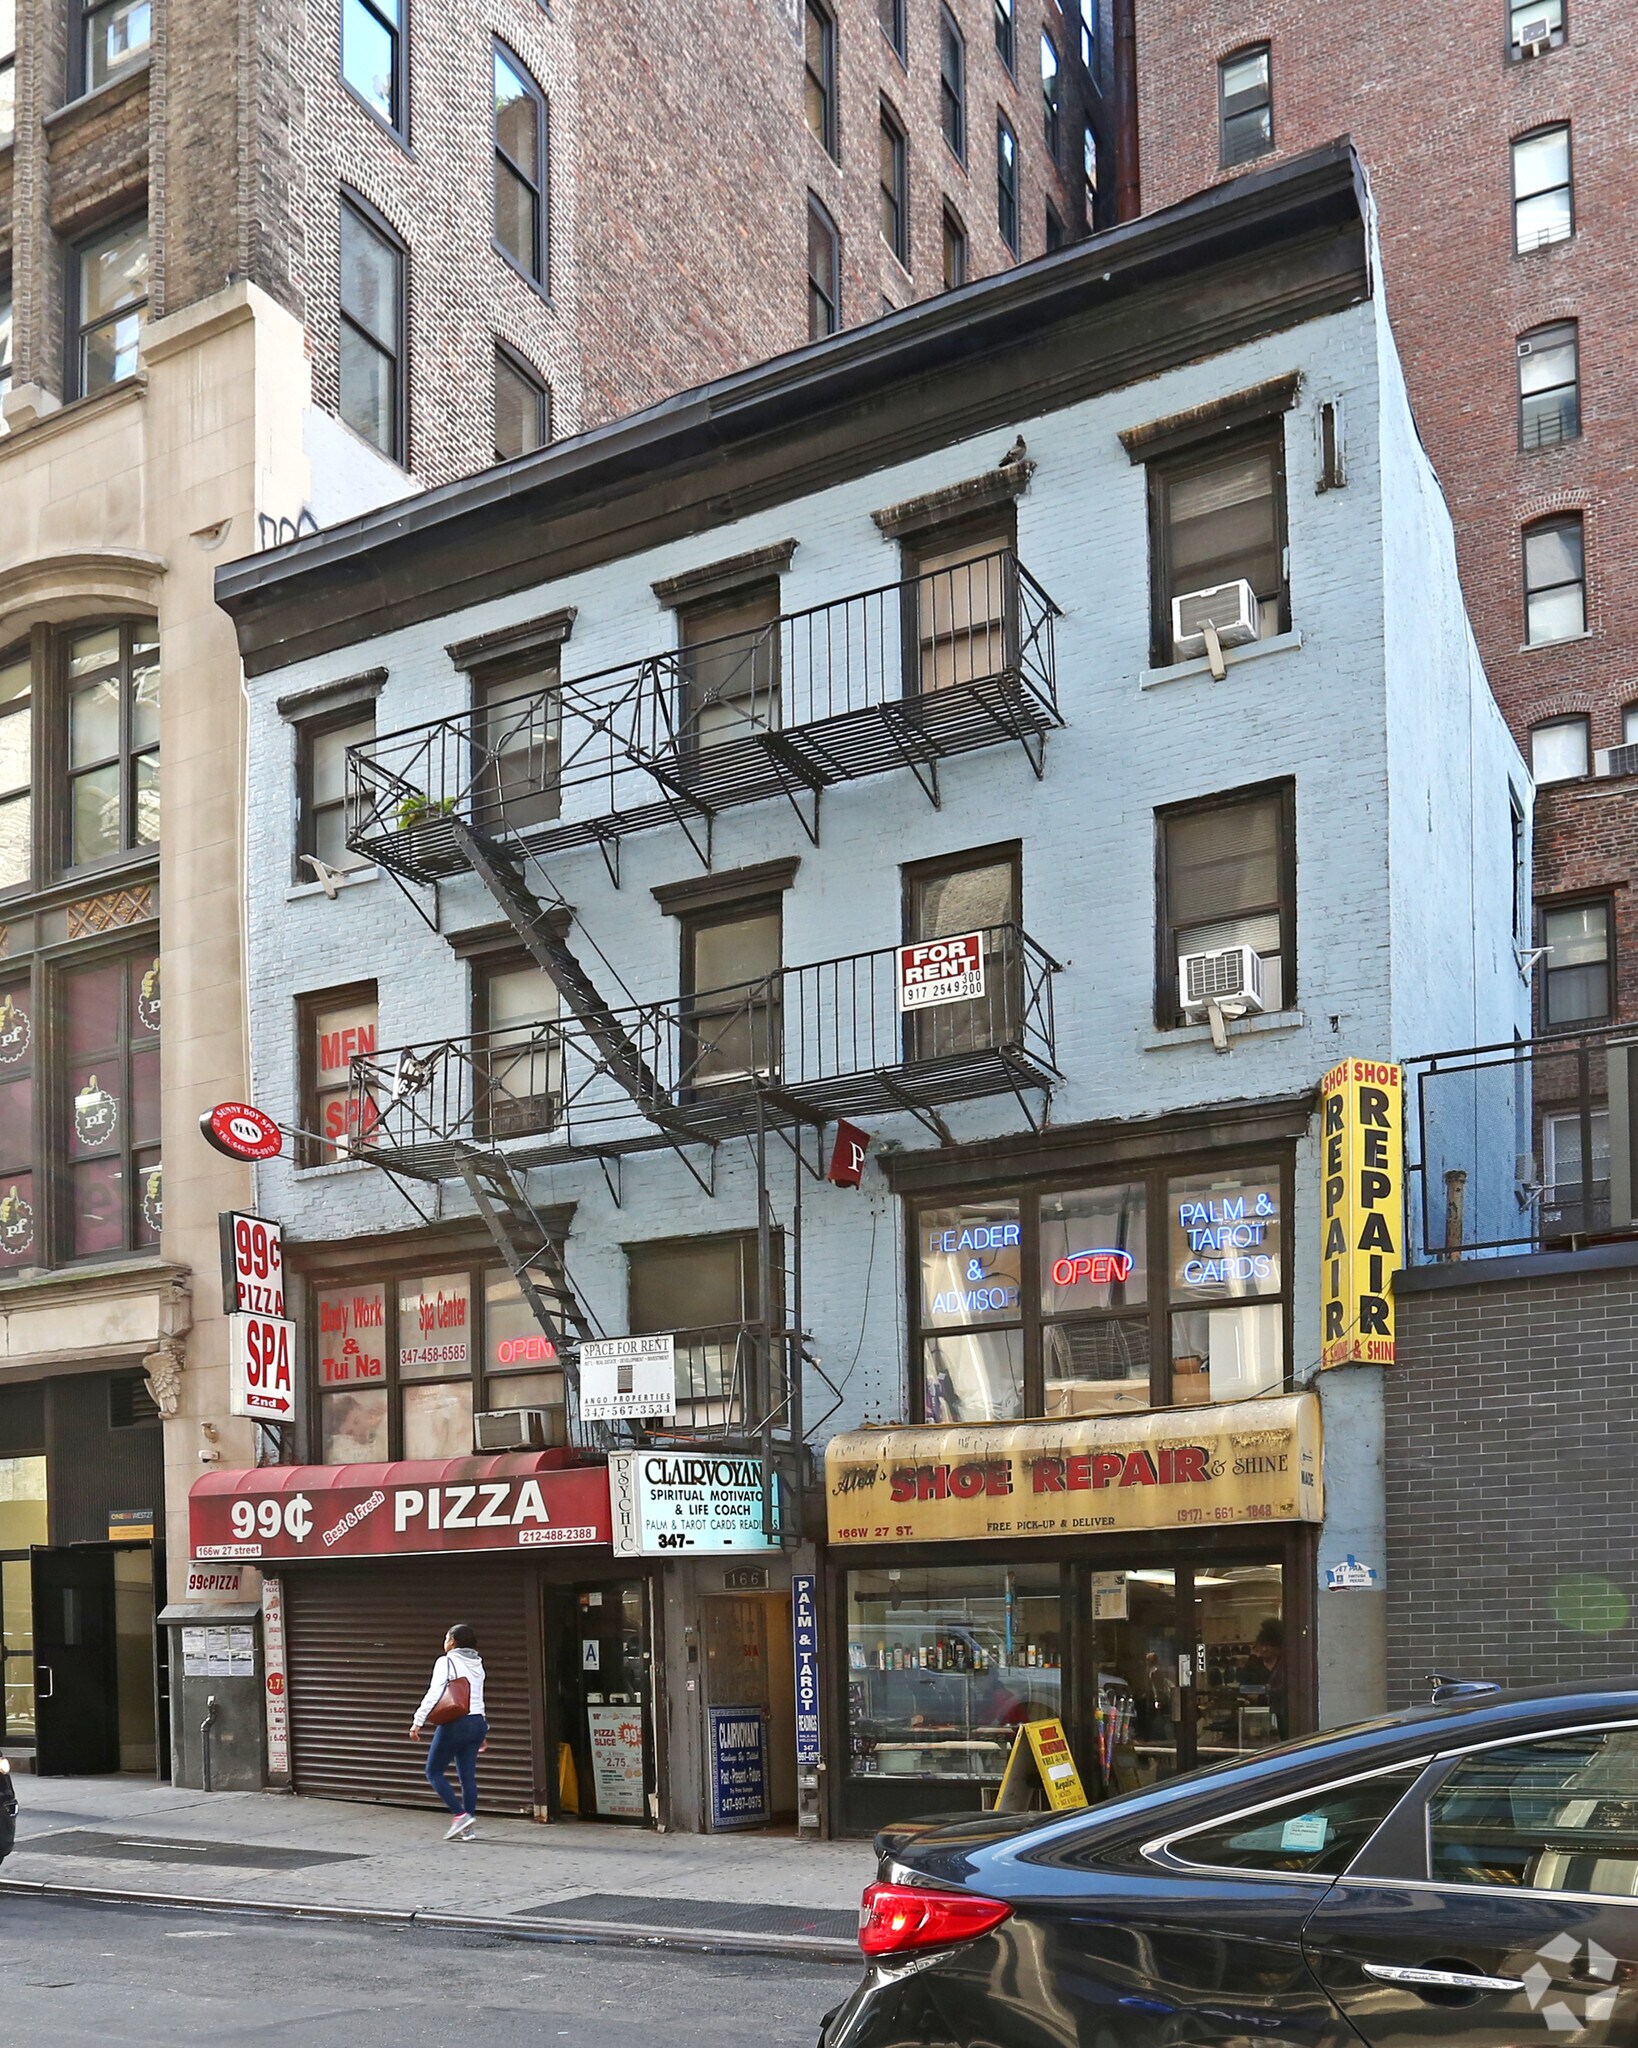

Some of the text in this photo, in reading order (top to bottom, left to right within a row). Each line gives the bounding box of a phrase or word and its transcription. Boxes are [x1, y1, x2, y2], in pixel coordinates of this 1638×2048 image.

[913, 940, 966, 961] FOR
[905, 955, 976, 985] RENT
[908, 987, 927, 1000] 917
[961, 970, 981, 984] 300
[962, 981, 982, 996] 200
[1, 1027, 22, 1047] pf
[321, 1024, 375, 1072] MEN
[1323, 1062, 1348, 1096] SHOE
[1354, 1062, 1398, 1087] SHOE
[84, 1109, 107, 1129] pf
[215, 1106, 275, 1134] SUNNY BOY SPA
[233, 1122, 258, 1139] MAN
[325, 1096, 379, 1140] SPA
[848, 1141, 865, 1172] P
[1180, 1193, 1274, 1227] PALM &
[1325, 1093, 1346, 1341] REPAIR
[1358, 1086, 1395, 1335] REPAIR
[6, 1218, 27, 1237] pf
[929, 1224, 1020, 1251] READER
[1187, 1223, 1265, 1250] TAROT
[236, 1220, 281, 1280] 99¢
[967, 1258, 983, 1281] &
[1052, 1257, 1128, 1286] OPEN
[1184, 1254, 1271, 1284] CARDS
[237, 1282, 285, 1318] PIZZA
[353, 1295, 383, 1329] Work
[932, 1286, 1020, 1314] ADVISOR
[419, 1289, 466, 1340] Spa Center
[247, 1320, 290, 1391] SPA
[342, 1338, 360, 1355] &
[401, 1344, 466, 1365] 347-458-6585
[498, 1336, 553, 1363] OPEN
[584, 1338, 669, 1356] SPACE FOR RENT
[1353, 1339, 1362, 1359] &
[322, 1354, 381, 1382] Tui Na
[251, 1396, 277, 1408] 2nd
[613, 1393, 671, 1403] PROPERTIES
[645, 1458, 773, 1487] CLAIRVOYAN
[890, 1459, 1013, 1502] SHOE
[1033, 1446, 1212, 1493] REPAIR
[1211, 1460, 1226, 1476] &
[1232, 1454, 1288, 1475] SHINE
[616, 1458, 633, 1552] PSYCHIC
[650, 1489, 770, 1502] SPIRITUAL MOTIVATO
[231, 1480, 550, 1543] 99¢ PIZZA
[324, 1490, 385, 1546] Best & Fresh
[675, 1505, 751, 1516] & LIFE COACH
[987, 1517, 1116, 1531] FREE PICK-UP & DELIVER
[1177, 1508, 1202, 1521] (917)
[1215, 1507, 1233, 1518] 661
[522, 1528, 592, 1543] 212-488-2388
[646, 1519, 779, 1531] PALM & TAROT CARDS READIS
[838, 1525, 914, 1538] 166W 27 ST.
[198, 1545, 260, 1556] 166w 27 street
[731, 1572, 759, 1586] 166
[798, 1581, 812, 1627] PALM
[586, 1644, 597, 1661] A
[799, 1635, 811, 1645] &
[800, 1653, 813, 1710] TAROT
[594, 1729, 616, 1737] PIZZA
[595, 1738, 616, 1747] SLICE
